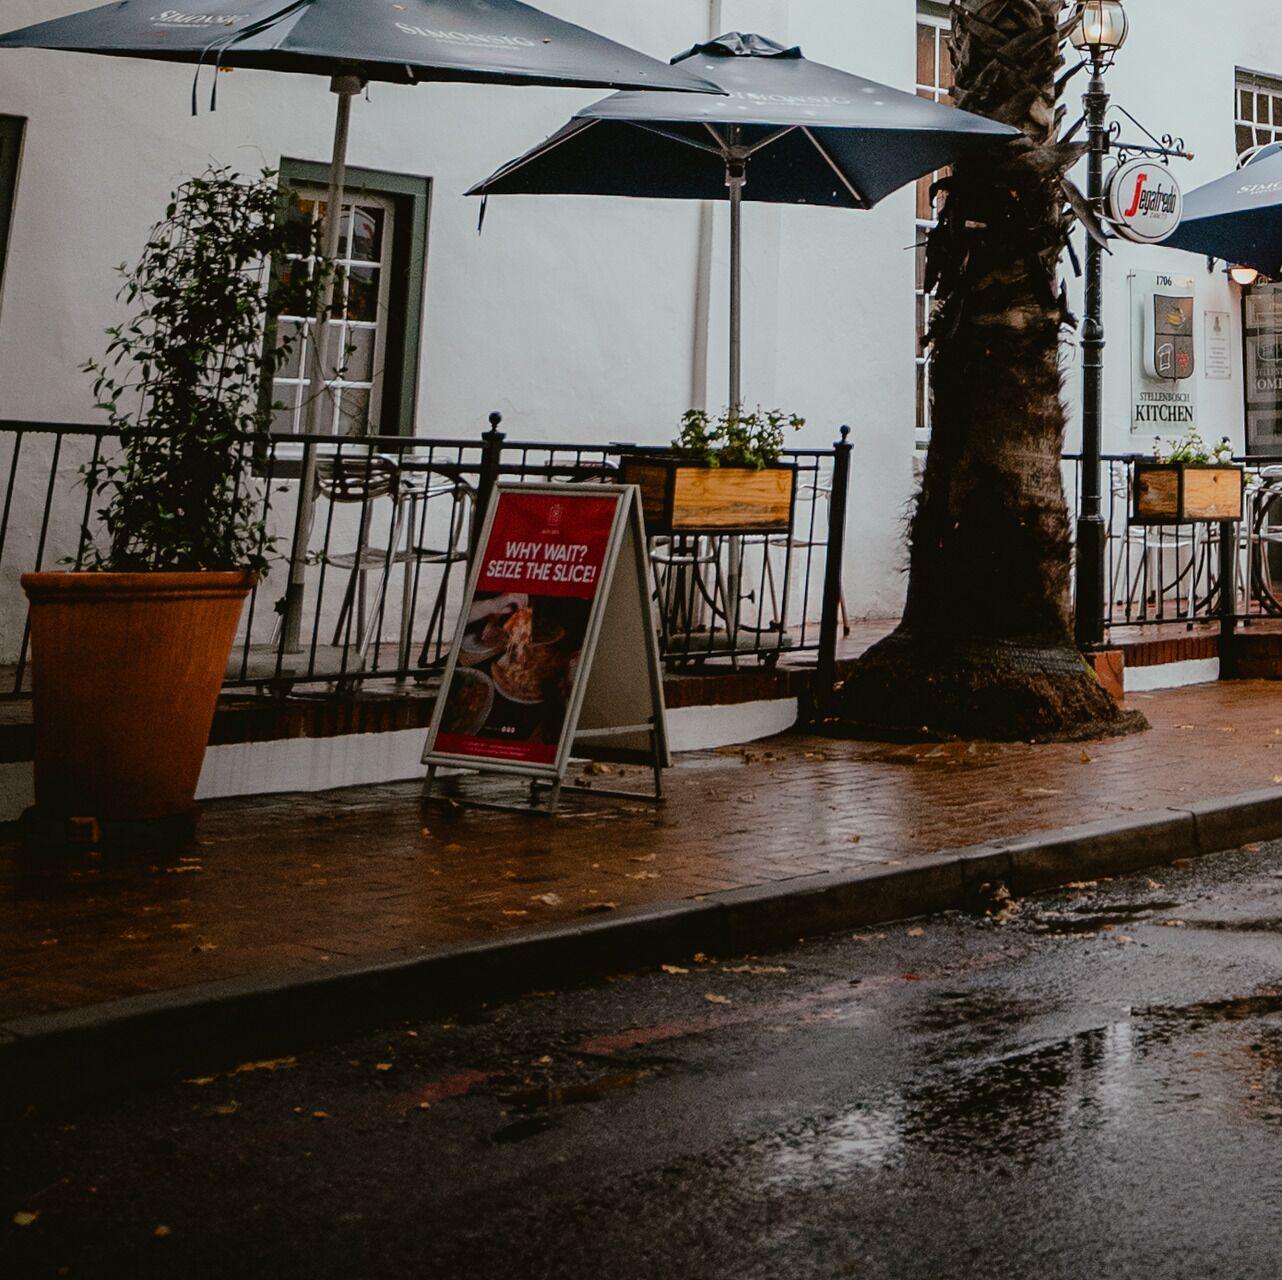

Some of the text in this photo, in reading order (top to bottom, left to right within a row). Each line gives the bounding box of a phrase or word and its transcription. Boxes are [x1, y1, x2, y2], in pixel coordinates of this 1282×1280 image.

[1124, 173, 1177, 217] Segafredo
[1156, 275, 1173, 287] 1706
[1140, 391, 1190, 402] STELLENBOSCH
[1136, 404, 1193, 422] KITCHEN
[506, 542, 588, 562] WHY WAIT?
[486, 560, 597, 583] SEIZE THE SLICE!
